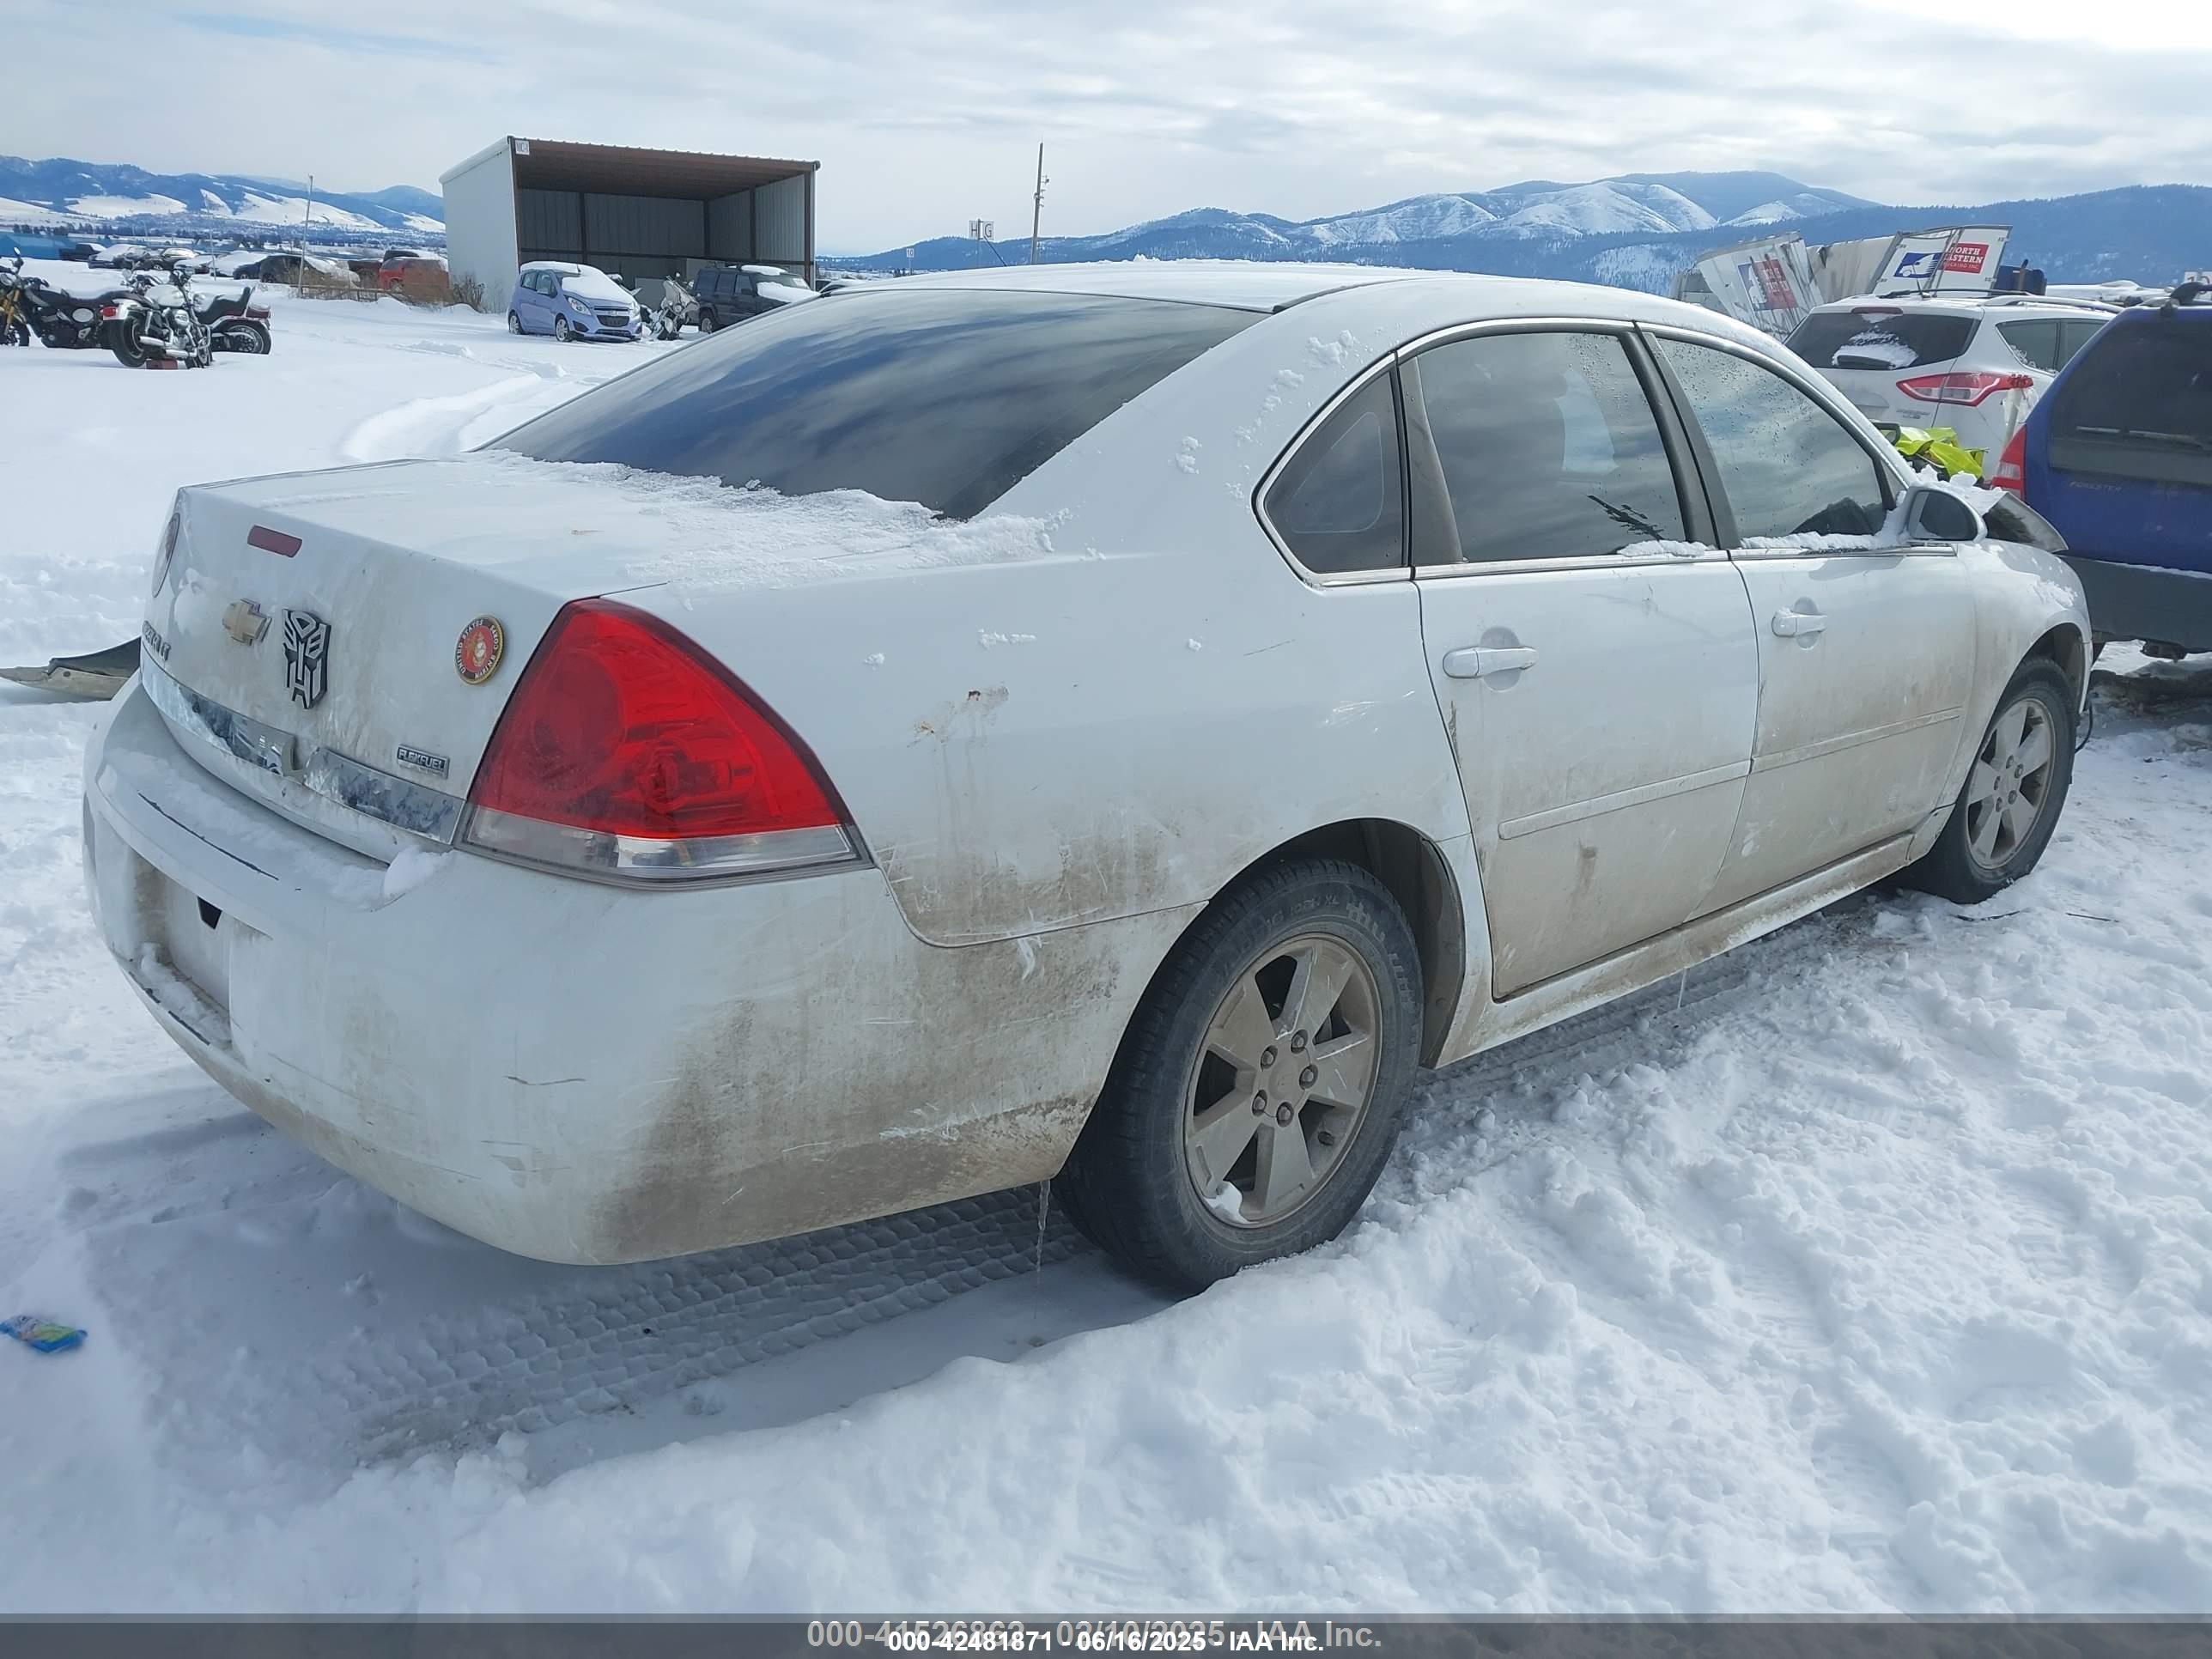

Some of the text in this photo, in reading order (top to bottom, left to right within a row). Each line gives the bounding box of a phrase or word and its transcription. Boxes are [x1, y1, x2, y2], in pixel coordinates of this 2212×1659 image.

[971, 222, 992, 237] H G
[457, 619, 483, 673] UNITED STATES
[474, 624, 499, 679] MARINE CORPS
